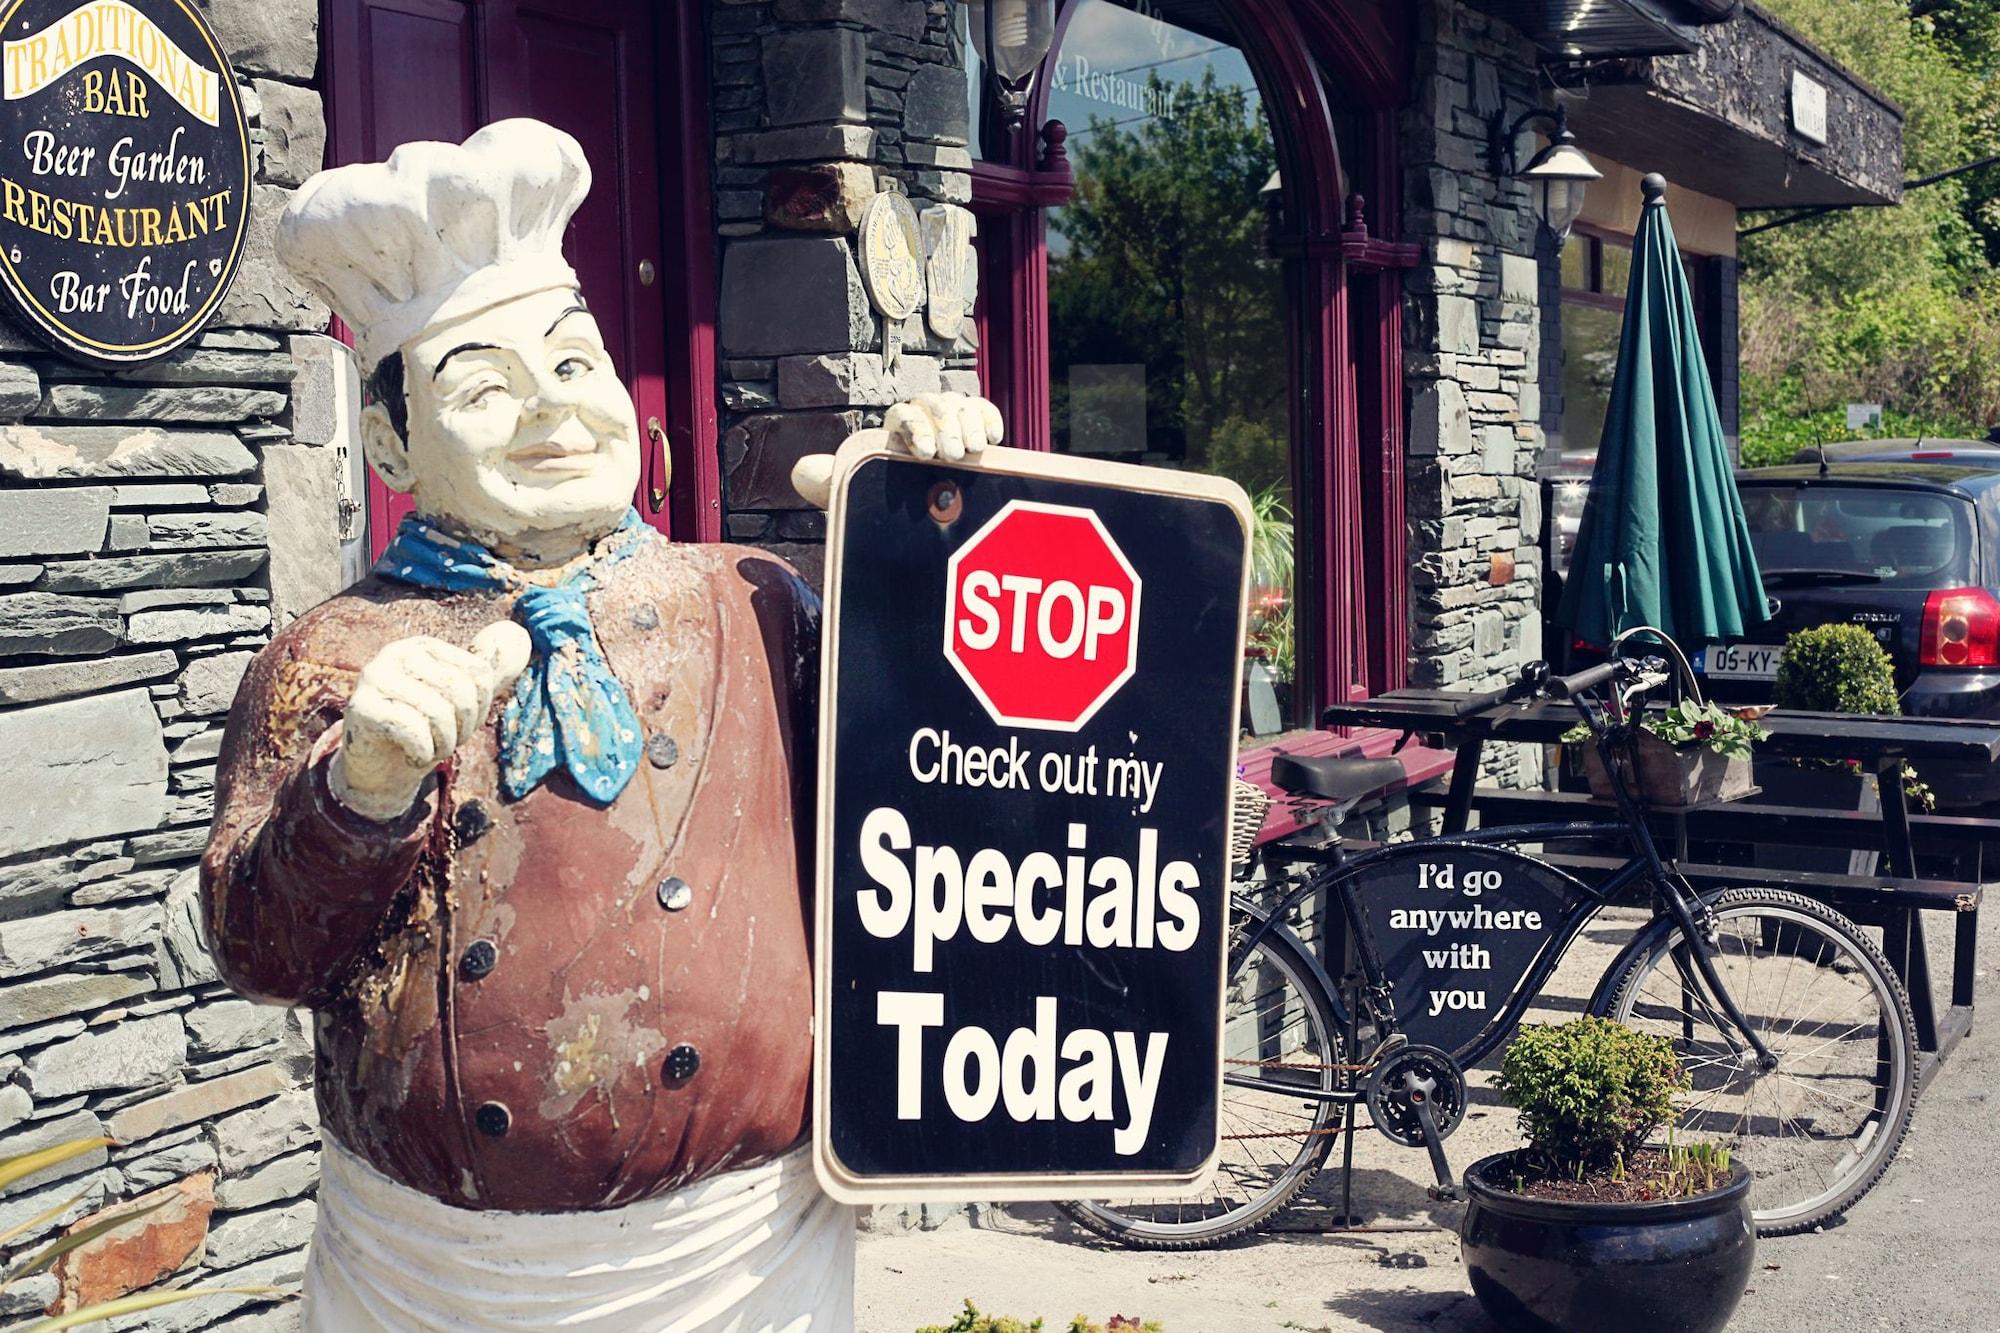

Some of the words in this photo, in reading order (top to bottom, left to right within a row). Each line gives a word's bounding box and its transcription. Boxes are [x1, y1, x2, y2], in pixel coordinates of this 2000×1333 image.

[7, 4, 217, 122] TRADITIONAL
[83, 68, 150, 119] BAR
[1074, 54, 1176, 120] Restaurant
[23, 130, 96, 176] Beer
[105, 126, 207, 200] Garden
[1, 177, 231, 248] RESTAURANT
[50, 270, 111, 314] Bar
[120, 256, 198, 320] Food
[958, 569, 1126, 661] STOP
[1716, 650, 1779, 672] 05-KY-
[909, 727, 1031, 790] Check
[1039, 744, 1099, 796] out
[1106, 755, 1164, 813] my
[856, 806, 1201, 973] Specials
[1418, 863, 1454, 890] I'd
[1463, 869, 1503, 897] go
[1389, 904, 1542, 937] anywhere
[1422, 943, 1491, 970] with
[1428, 990, 1487, 1017] you
[876, 990, 1170, 1156] Today
